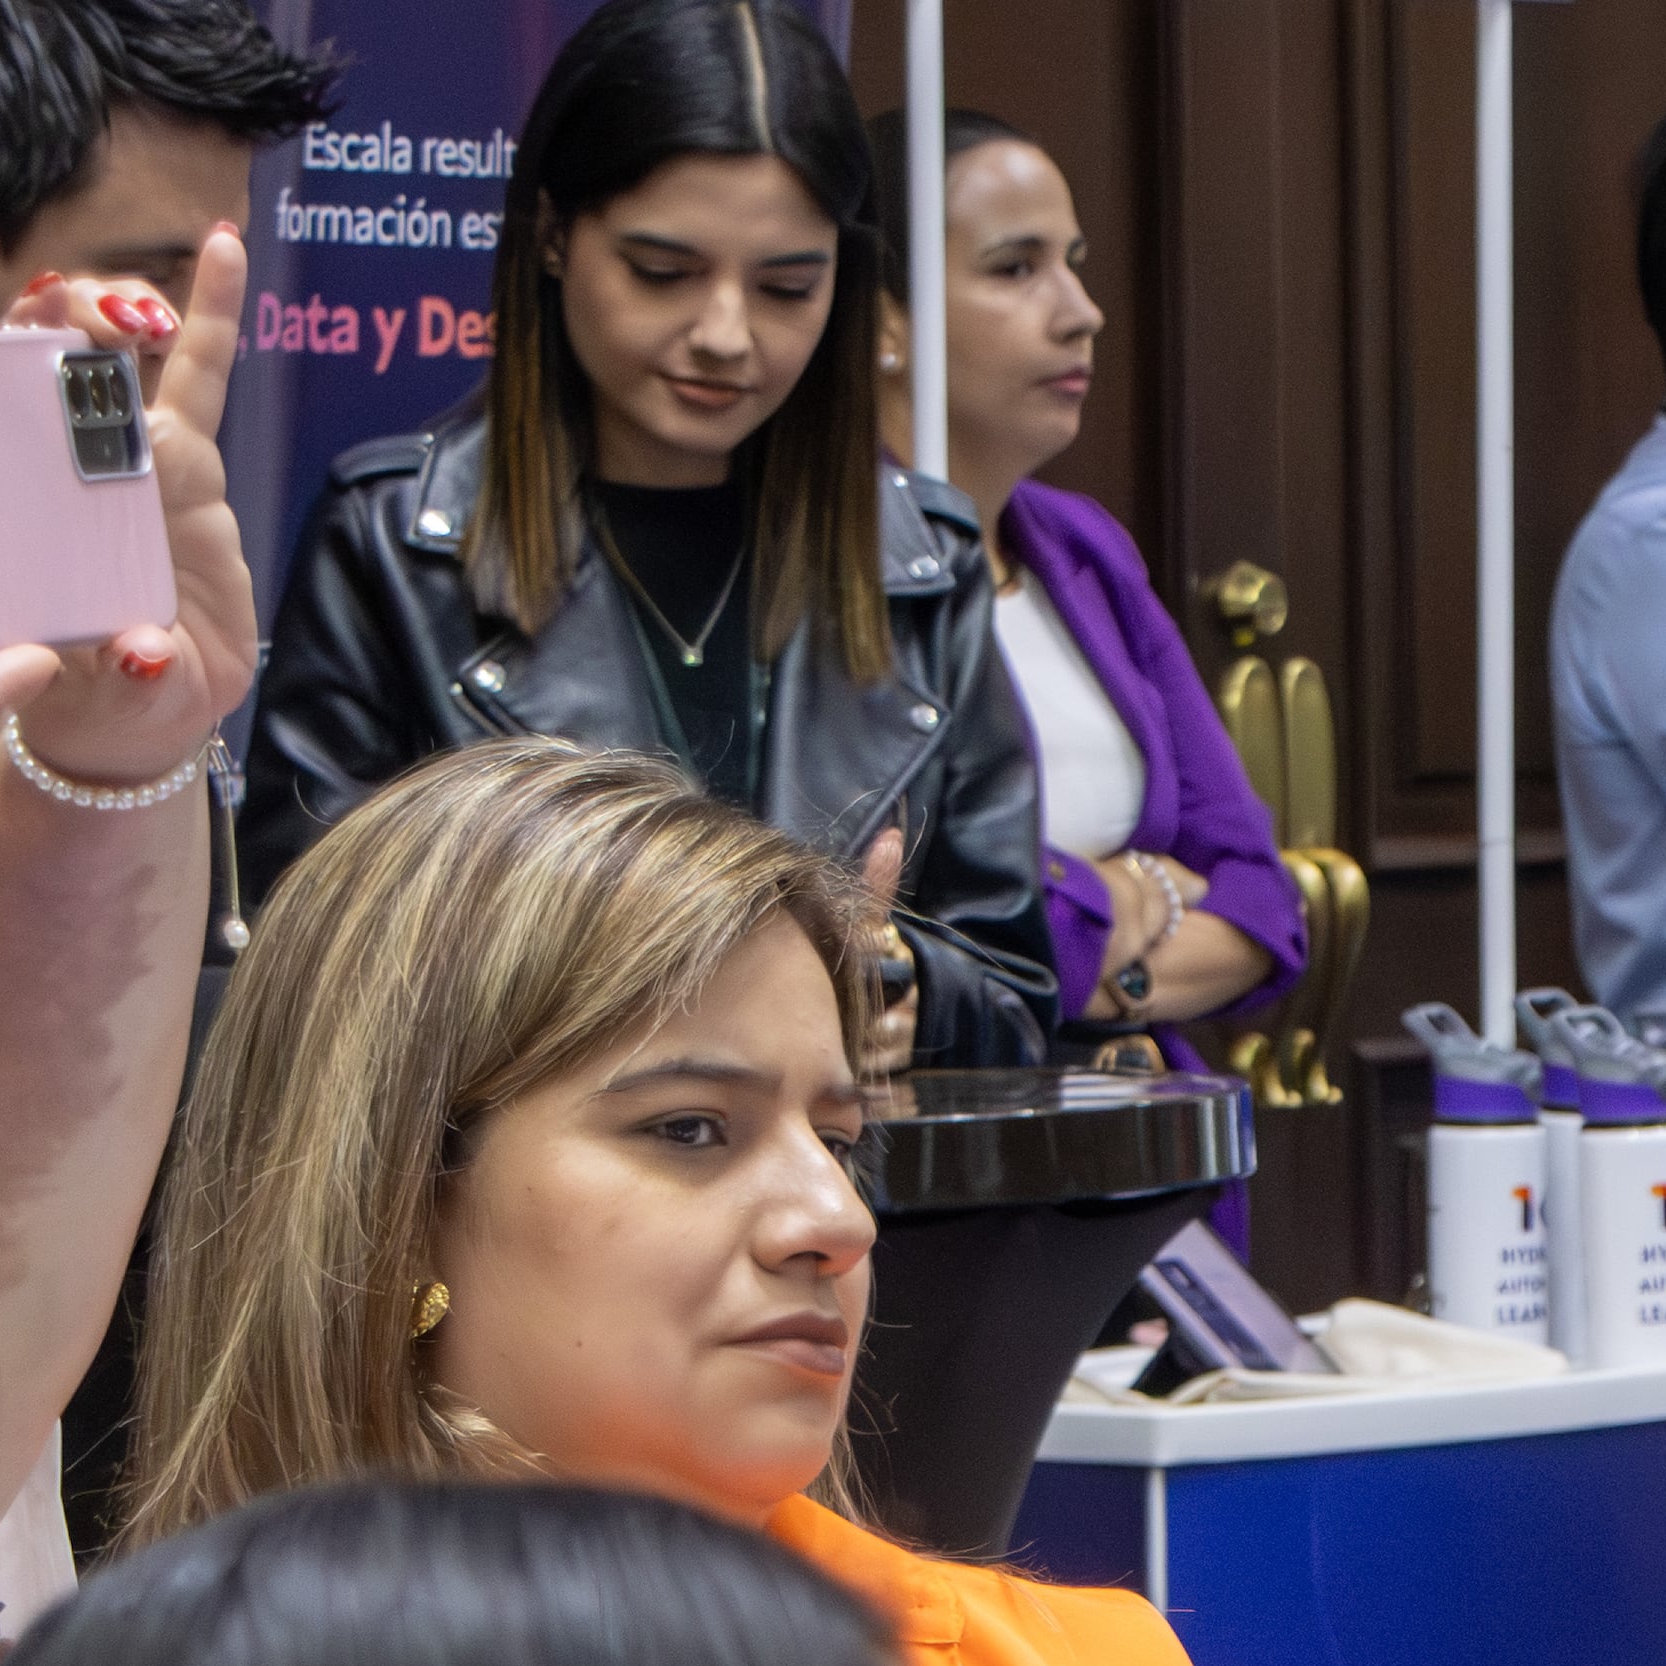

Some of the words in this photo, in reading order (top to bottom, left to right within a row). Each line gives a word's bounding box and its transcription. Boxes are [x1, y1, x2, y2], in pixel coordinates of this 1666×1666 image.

[302, 121, 412, 174] Escala
[276, 187, 452, 248] formación
[459, 212, 504, 250] es
[256, 292, 360, 354] Data
[372, 306, 407, 375] y
